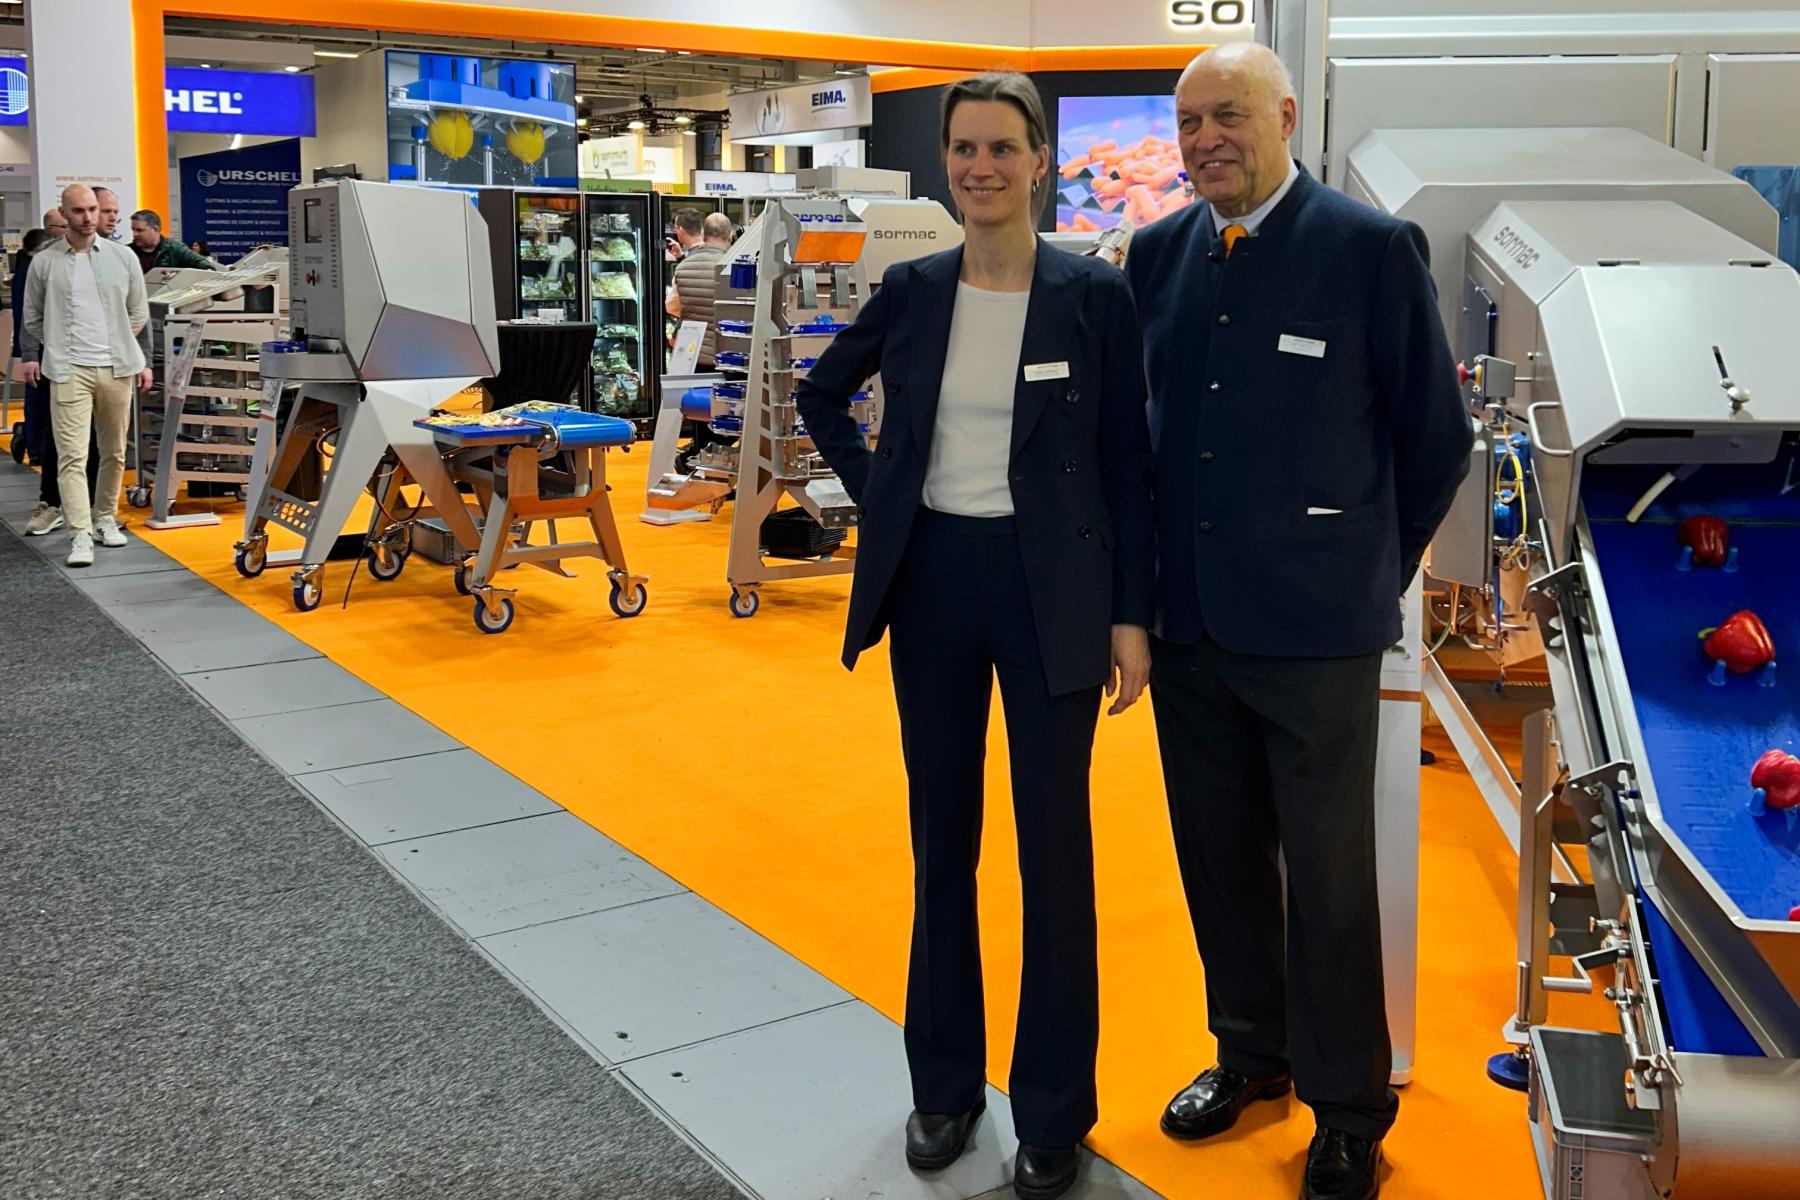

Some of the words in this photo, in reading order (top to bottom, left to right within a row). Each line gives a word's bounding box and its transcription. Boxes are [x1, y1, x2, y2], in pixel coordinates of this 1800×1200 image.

[218, 169, 301, 182] URSCHEL
[873, 229, 937, 240] sormac
[1494, 226, 1540, 270] sormac
